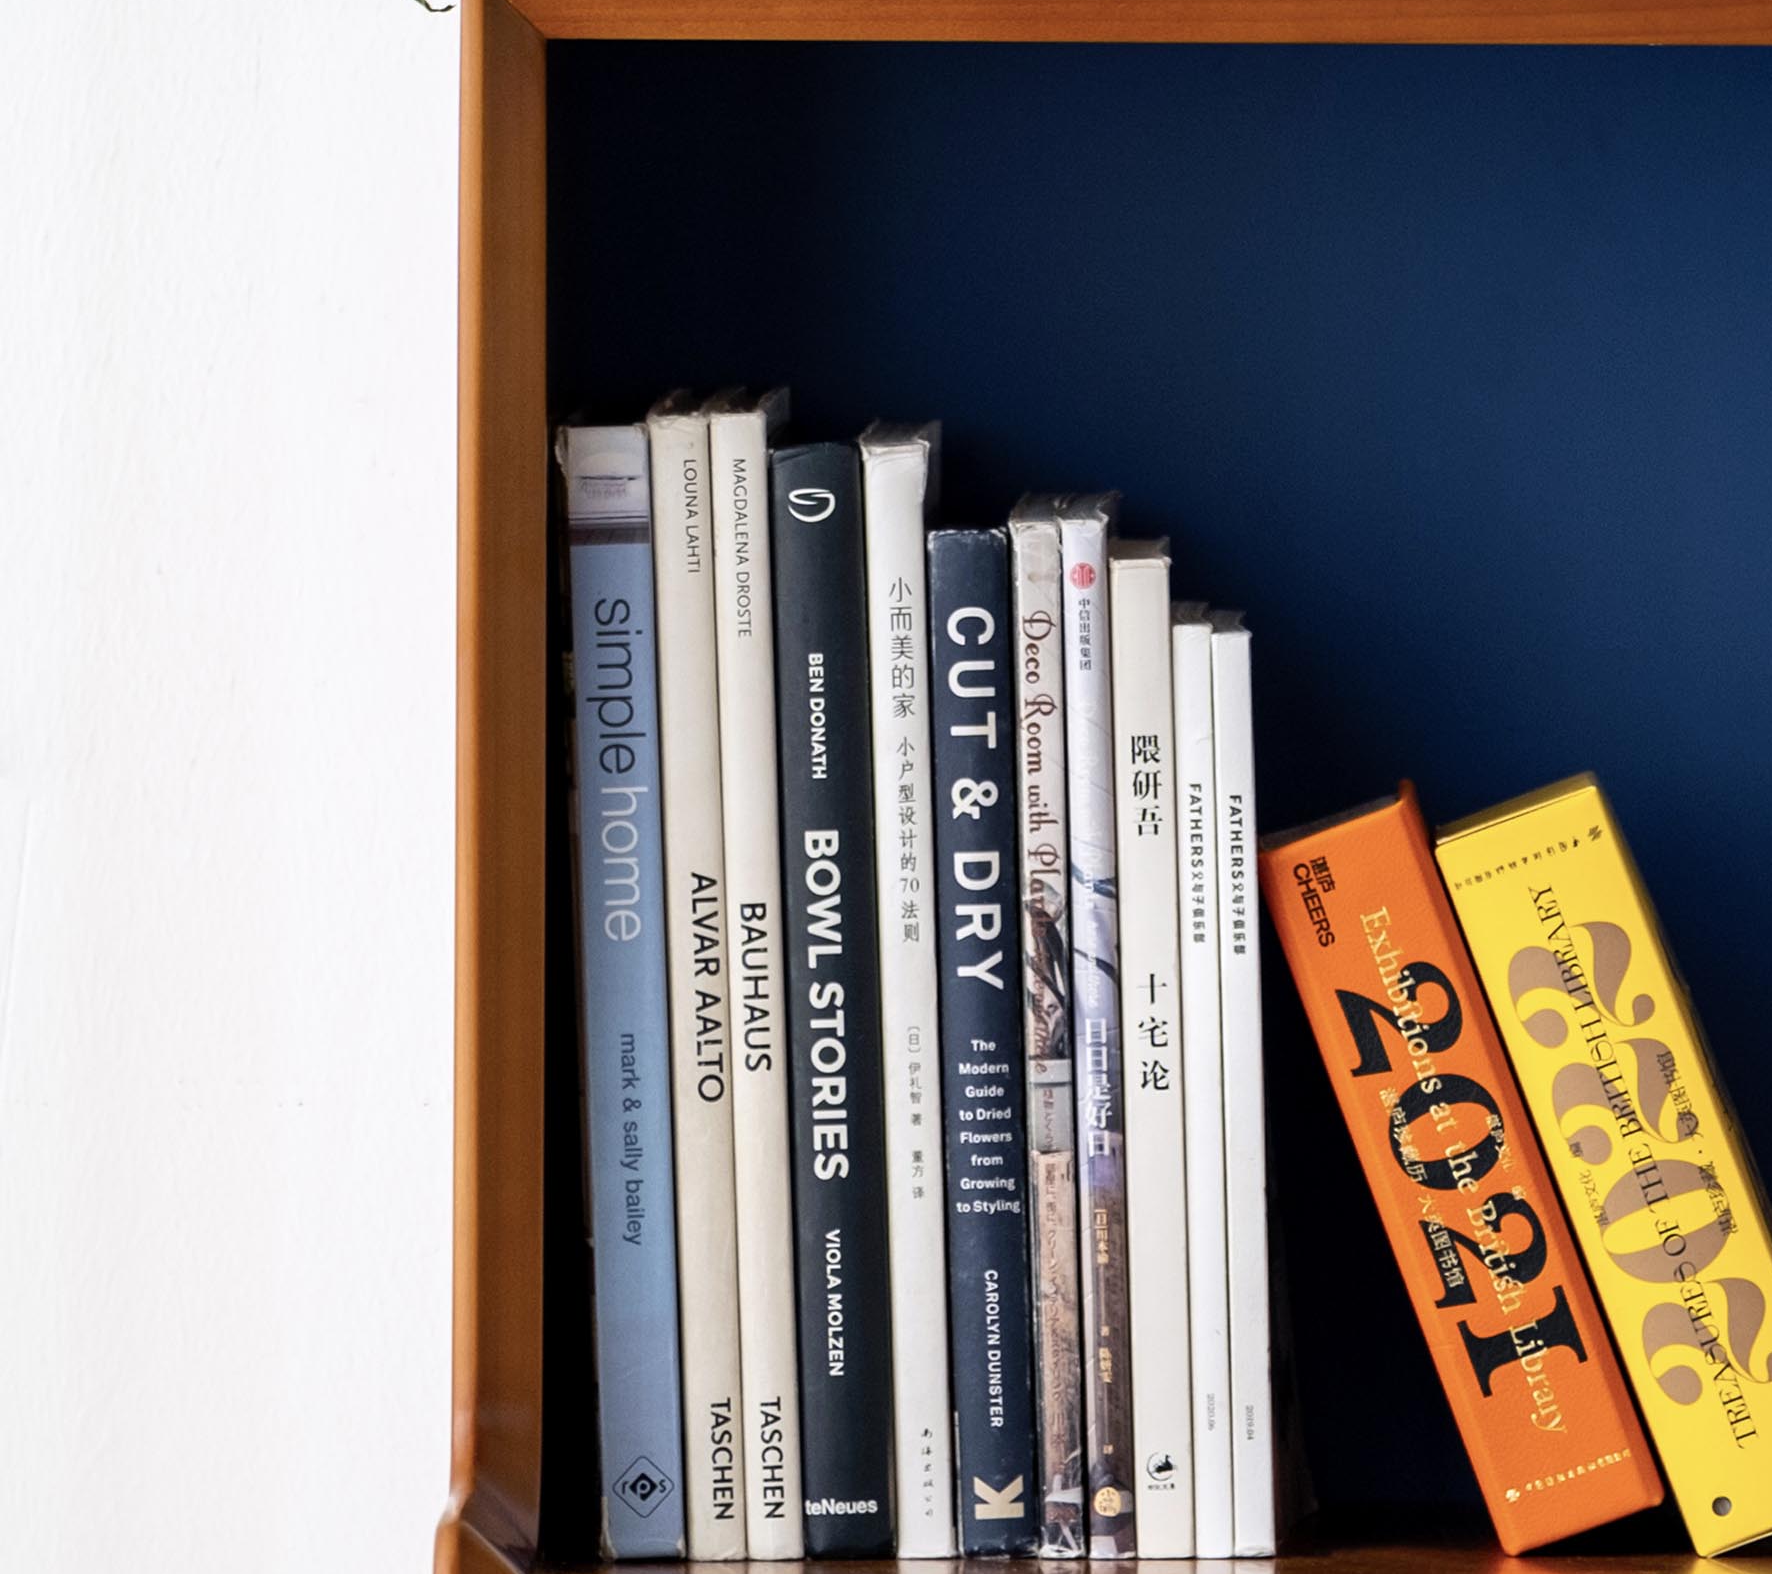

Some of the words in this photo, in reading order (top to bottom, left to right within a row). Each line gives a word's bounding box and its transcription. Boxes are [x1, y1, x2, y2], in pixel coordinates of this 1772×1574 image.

[683, 459, 699, 520] LOUNA
[733, 459, 749, 566] MAGDALENA
[686, 525, 701, 574] LAHTI
[736, 571, 752, 638] DROSTE
[586, 598, 647, 775] simple
[808, 653, 824, 694] BEN
[889, 576, 916, 719] 小而美的家
[946, 606, 997, 750] CUT
[1022, 610, 1056, 684] Deco
[809, 698, 827, 780] DONATH
[1021, 693, 1058, 775] Room
[950, 777, 999, 820] &
[1028, 784, 1060, 833] with
[1130, 734, 1164, 836] 隈研吾
[1188, 782, 1205, 869] FATHERS
[601, 786, 649, 942] home
[896, 736, 920, 943] 小户型设计的70法则
[1229, 794, 1245, 880] FATHERS
[691, 872, 721, 977] ALVAR
[804, 829, 843, 969] BOWL
[953, 850, 1005, 990] DRY
[1291, 861, 1336, 949] CHEERS
[740, 902, 772, 1072] BAUHAUS
[1528, 884, 1596, 1011] LIBRARY
[620, 1032, 641, 1090] mark
[694, 989, 725, 1103] AALTO
[958, 1062, 1010, 1075] Modern
[970, 1038, 996, 1052] The
[1135, 973, 1170, 1092] 十宅论
[622, 1097, 643, 1113] &
[808, 981, 850, 1181] STORIES
[958, 1109, 974, 1122] to
[976, 1107, 1012, 1121] Dried
[964, 1085, 1005, 1098] Guide
[1580, 1016, 1643, 1139] BRITISH
[620, 1120, 644, 1171] sally
[959, 1131, 1013, 1144] Flowers
[970, 1154, 1004, 1166] from
[1359, 906, 1442, 1095] Exhibitions
[1429, 1102, 1459, 1133] at
[1445, 1139, 1480, 1194] the
[1466, 1200, 1526, 1315] British
[1508, 1318, 1568, 1434] Library
[1627, 1142, 1670, 1214] THE
[623, 1179, 645, 1246] bailey
[956, 1201, 971, 1213] to
[973, 1200, 1021, 1215] Styling
[960, 1177, 1016, 1192] Growing
[1334, 960, 1588, 1398] 2021
[825, 1228, 843, 1290] VIOLA
[1655, 1216, 1687, 1257] OF
[827, 1293, 844, 1377] MOLZEN
[983, 1269, 1001, 1346] CAROLYN
[987, 1350, 1004, 1428] DUNSTER
[1673, 1261, 1758, 1450] TREASURES
[710, 1397, 735, 1520] TASCHEN
[760, 1396, 785, 1519] TASCHEN
[973, 1475, 1025, 1521] K
[804, 1497, 878, 1517] teNeues
